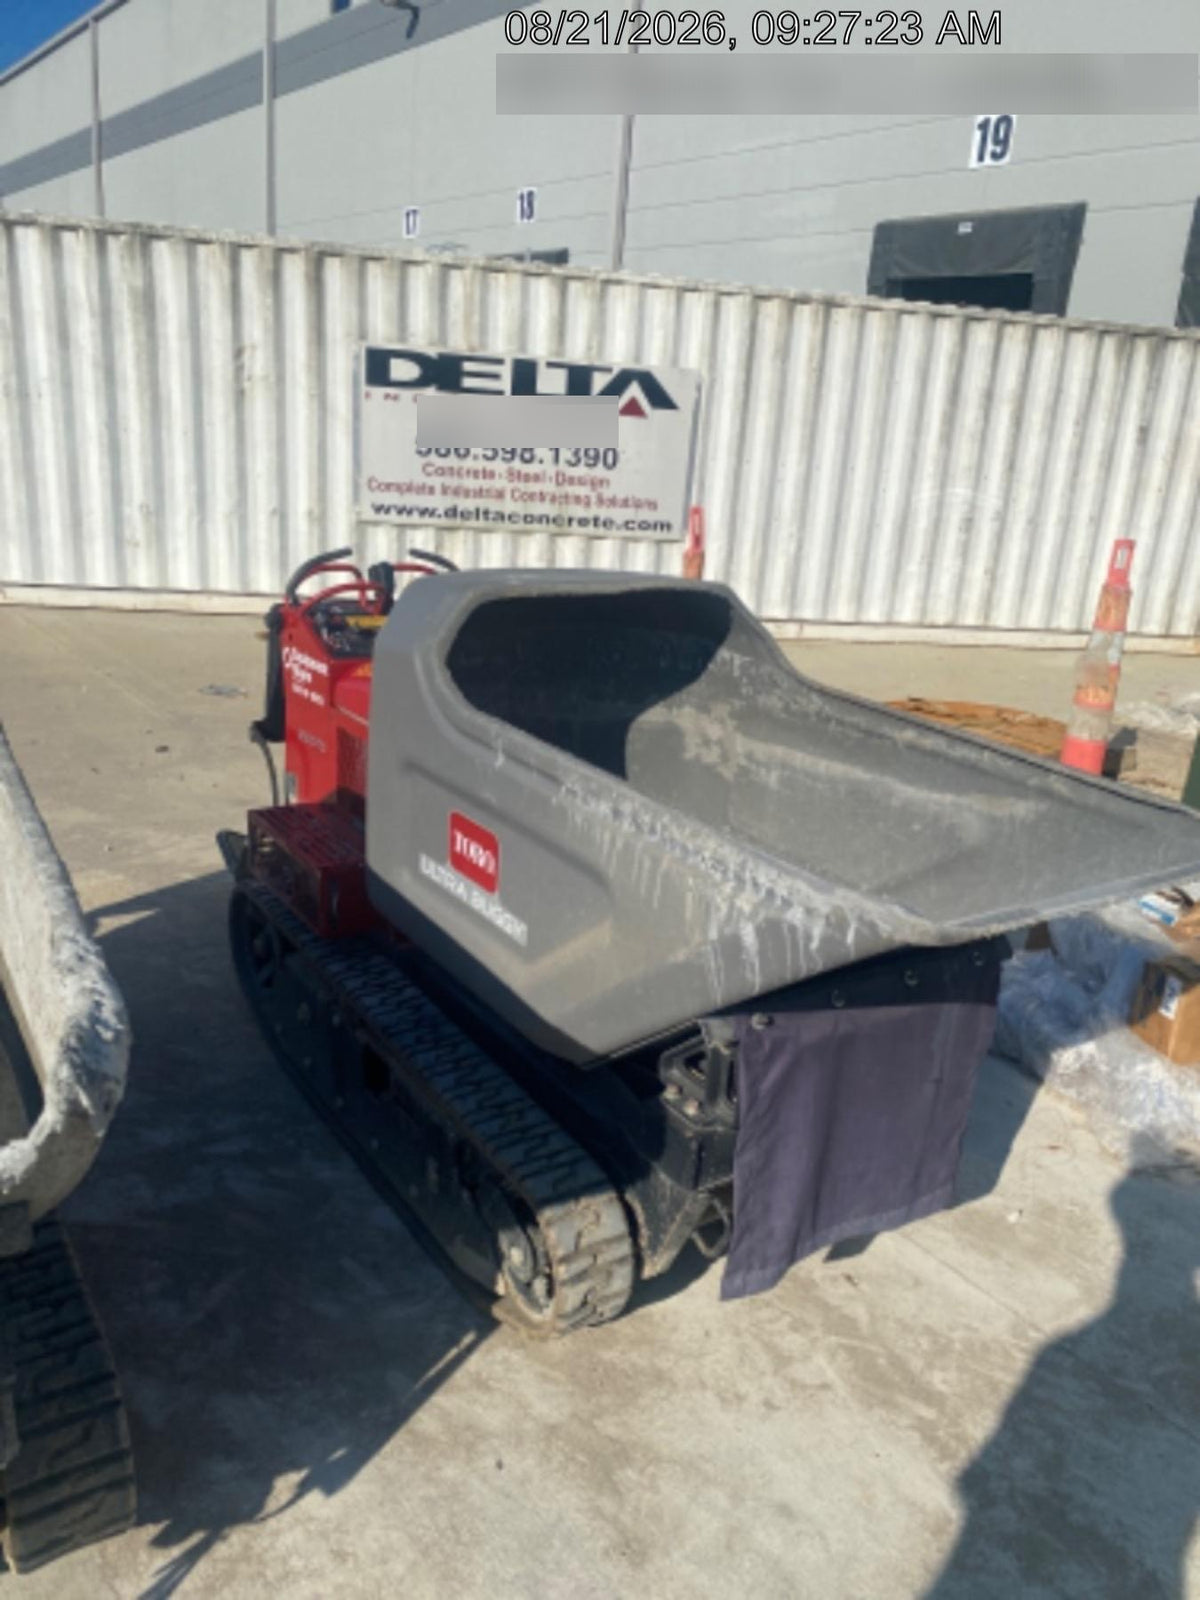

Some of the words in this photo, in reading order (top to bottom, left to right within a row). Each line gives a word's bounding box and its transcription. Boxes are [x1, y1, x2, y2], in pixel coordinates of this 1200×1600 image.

[977, 114, 1014, 162] 19
[519, 190, 534, 220] 18
[405, 209, 418, 235] 17
[365, 346, 680, 411] DELTA
[367, 476, 436, 496] Complete
[441, 482, 505, 499] Industrial
[511, 488, 591, 508] Contracting
[596, 493, 658, 511] Solutions
[371, 502, 673, 533] www.deltaconcrete.com
